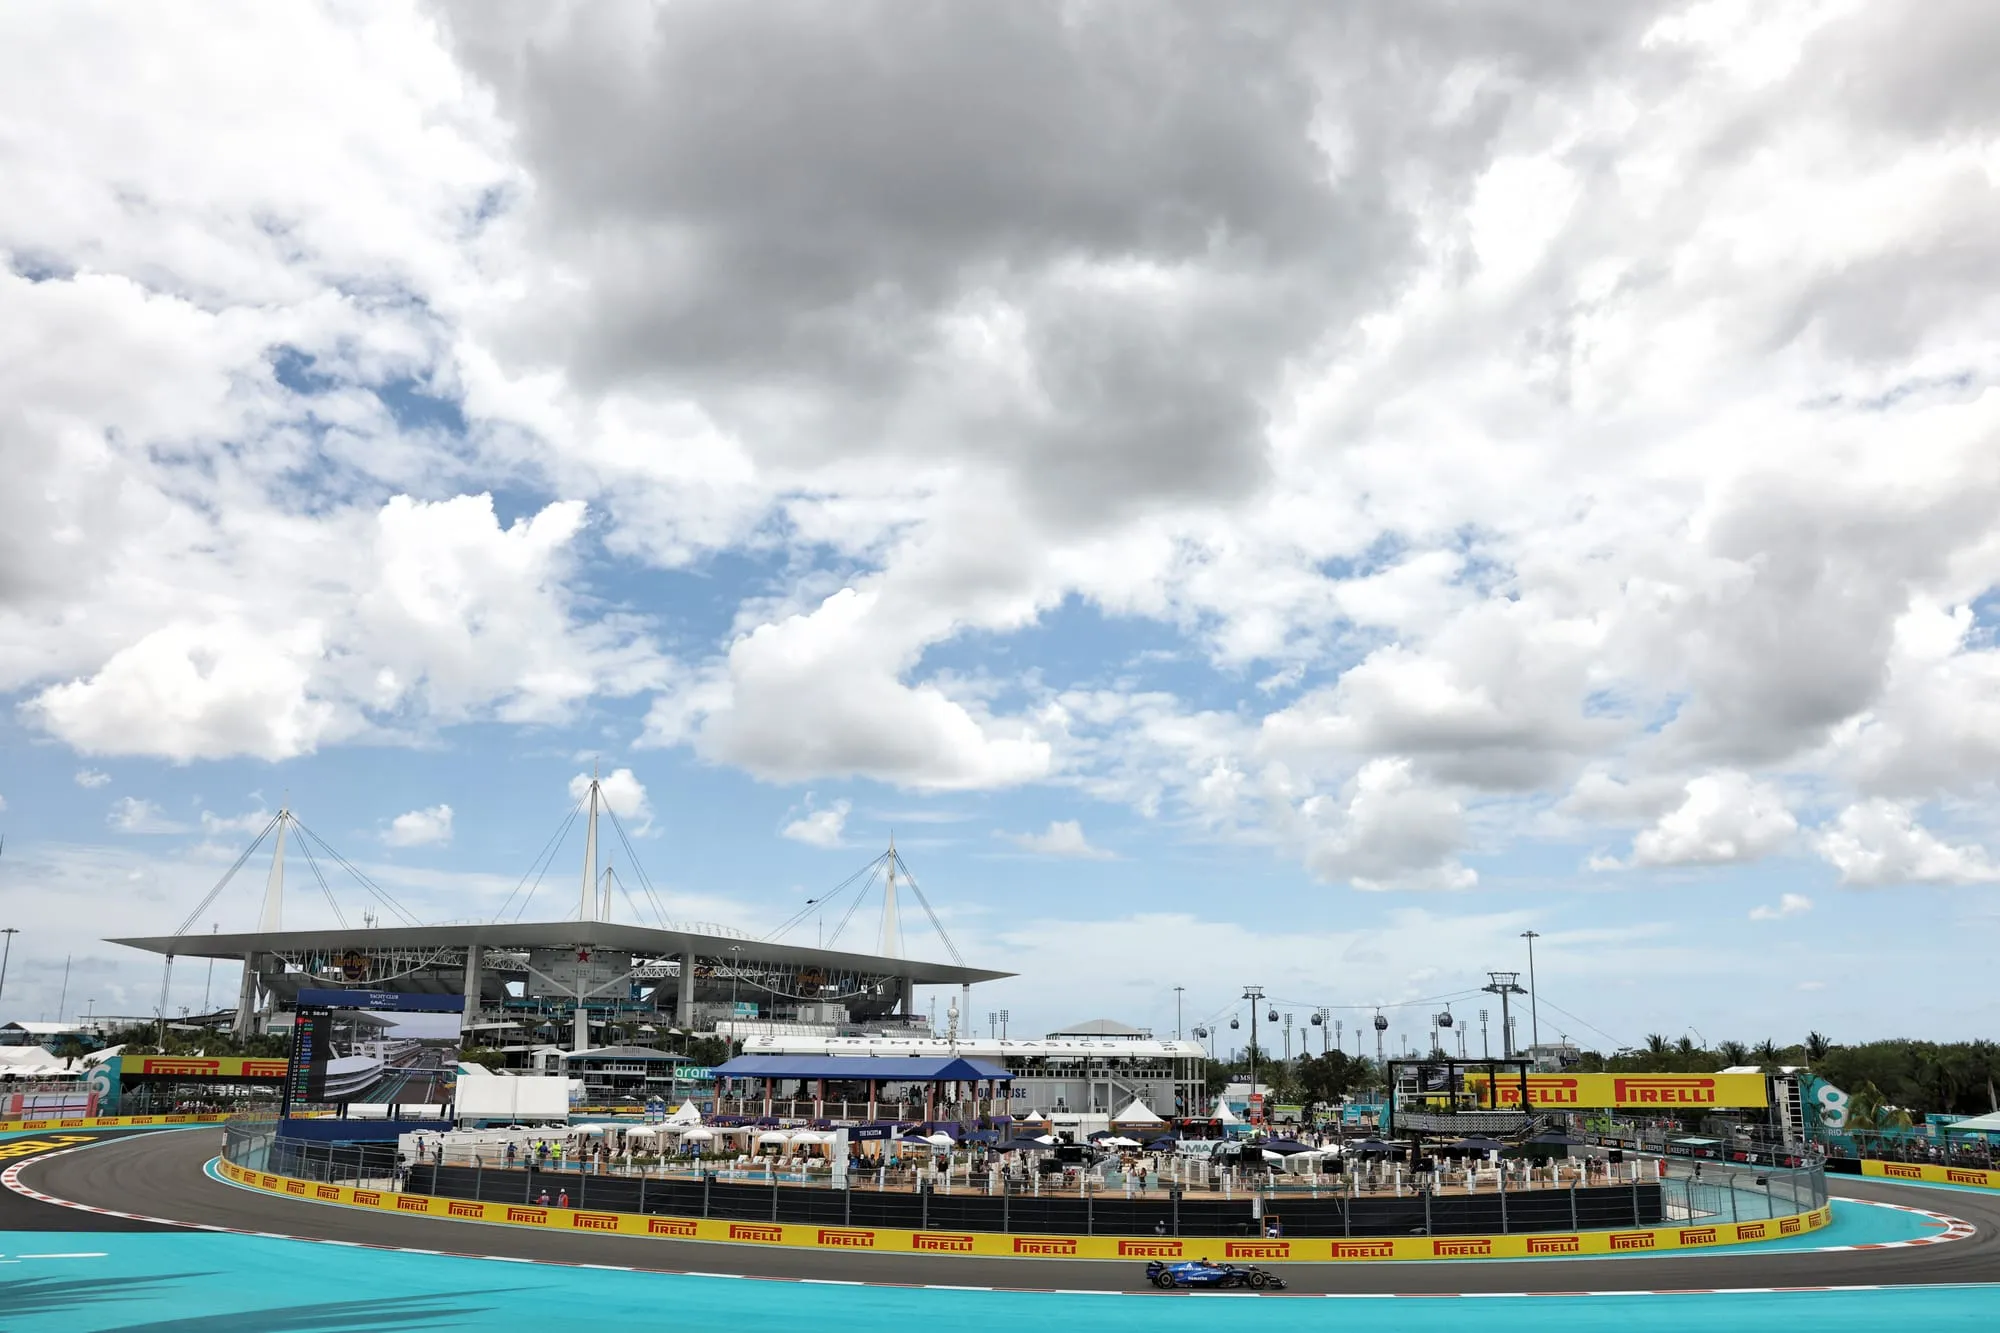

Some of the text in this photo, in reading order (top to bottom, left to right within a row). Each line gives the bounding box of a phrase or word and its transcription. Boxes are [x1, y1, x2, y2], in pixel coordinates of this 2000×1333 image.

[1614, 1079, 1715, 1103] PIRELLI
[1817, 1085, 1848, 1128] 8
[1670, 1146, 1691, 1155] KEEPER
[1884, 1164, 1922, 1179] PIRELLI
[1946, 1170, 1987, 1185] PIRELLI
[286, 1180, 306, 1195] PIRELLI
[317, 1185, 340, 1200] PIRELLI
[353, 1190, 380, 1206] PIRELLI
[397, 1196, 428, 1211] PIRELLI
[448, 1202, 484, 1218] PIRELLI
[507, 1207, 548, 1224] PIRELLI
[573, 1213, 618, 1230] PIRELLI
[648, 1219, 697, 1236] PIRELLI
[1780, 1218, 1800, 1234] PIRELLI
[730, 1224, 782, 1242] PIRELLI
[818, 1230, 874, 1247] PIRELLI
[1680, 1228, 1716, 1245] PIRELLI
[1737, 1223, 1765, 1240] PIRELLI
[913, 1234, 974, 1251] PIRELLI
[1014, 1238, 1077, 1255] PIRELLI
[1118, 1241, 1183, 1257] PIRELLI
[1332, 1241, 1393, 1257] PIRELLI
[1433, 1240, 1491, 1256] PIRELLI
[1527, 1236, 1579, 1253] PIRELLI
[1610, 1233, 1654, 1250] PIRELLI
[1226, 1242, 1290, 1258] PIRELLI
